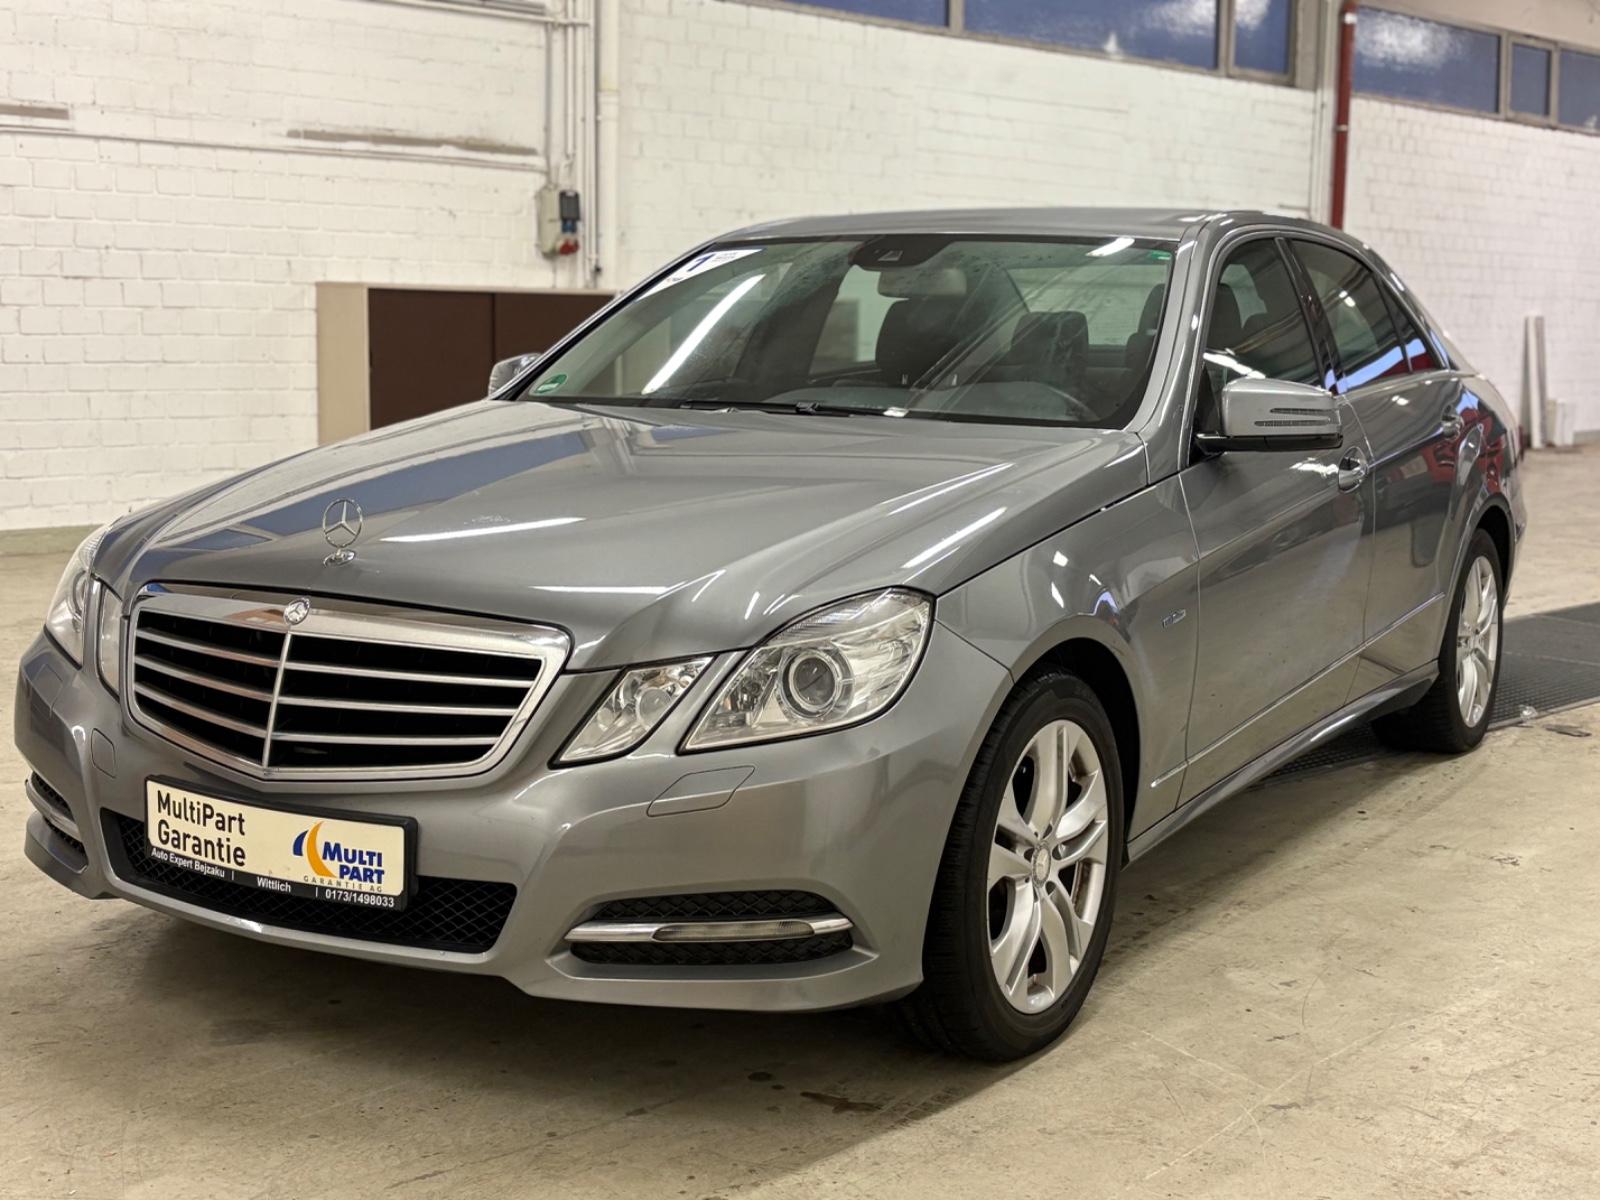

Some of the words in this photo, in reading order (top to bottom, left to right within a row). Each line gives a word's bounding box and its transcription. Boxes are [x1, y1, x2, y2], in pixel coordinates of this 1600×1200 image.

[158, 790, 246, 837] MultiPart
[158, 819, 246, 866] Garantie
[322, 842, 382, 867] MULTI
[151, 847, 168, 861] Auto
[169, 853, 193, 869] Expert
[194, 861, 225, 878] Bejzaku
[257, 876, 292, 893] Wittlich
[325, 889, 394, 908] 0173/1498033
[303, 875, 362, 891] GARANTIE
[370, 885, 382, 893] AG
[339, 864, 385, 884] PART
